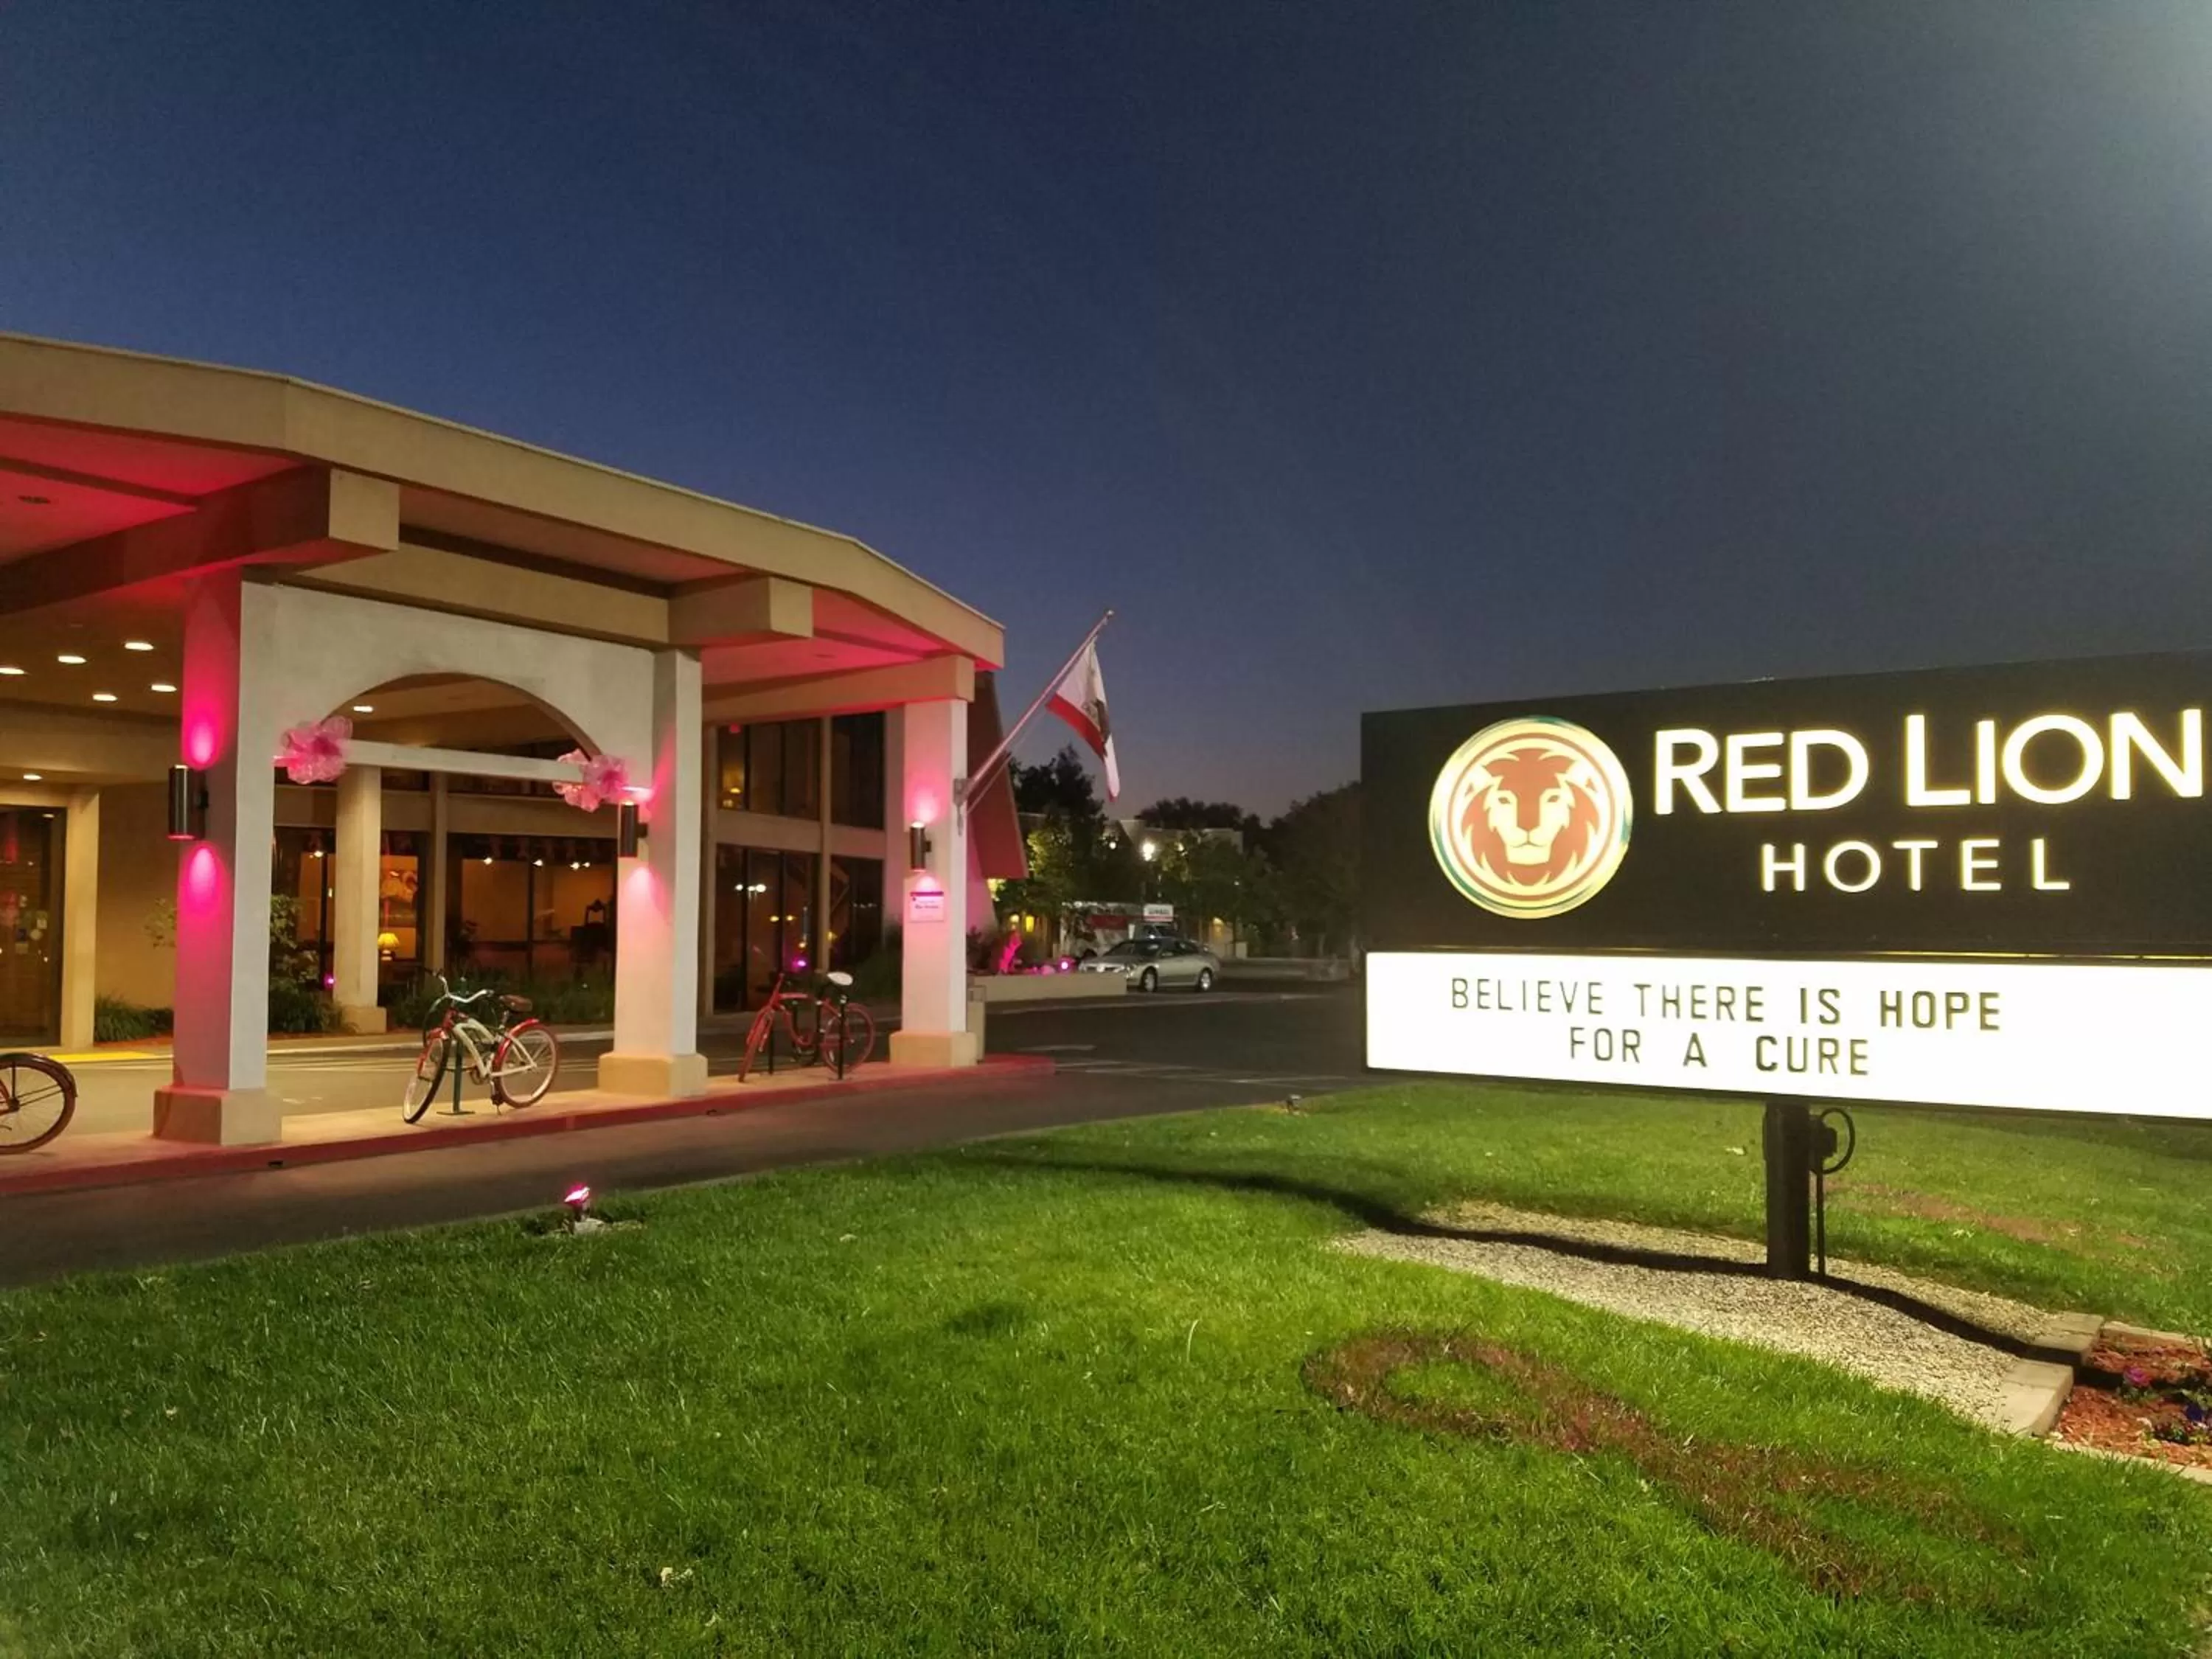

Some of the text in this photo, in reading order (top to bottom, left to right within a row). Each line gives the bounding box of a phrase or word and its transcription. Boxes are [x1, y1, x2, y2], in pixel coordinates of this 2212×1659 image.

[1654, 707, 2205, 815] RED LION
[1761, 838, 2071, 893] HOTEL
[1452, 977, 2000, 1031] BELIEVE THERE IS HOPE
[1570, 1026, 1868, 1076] FOR A CURE
